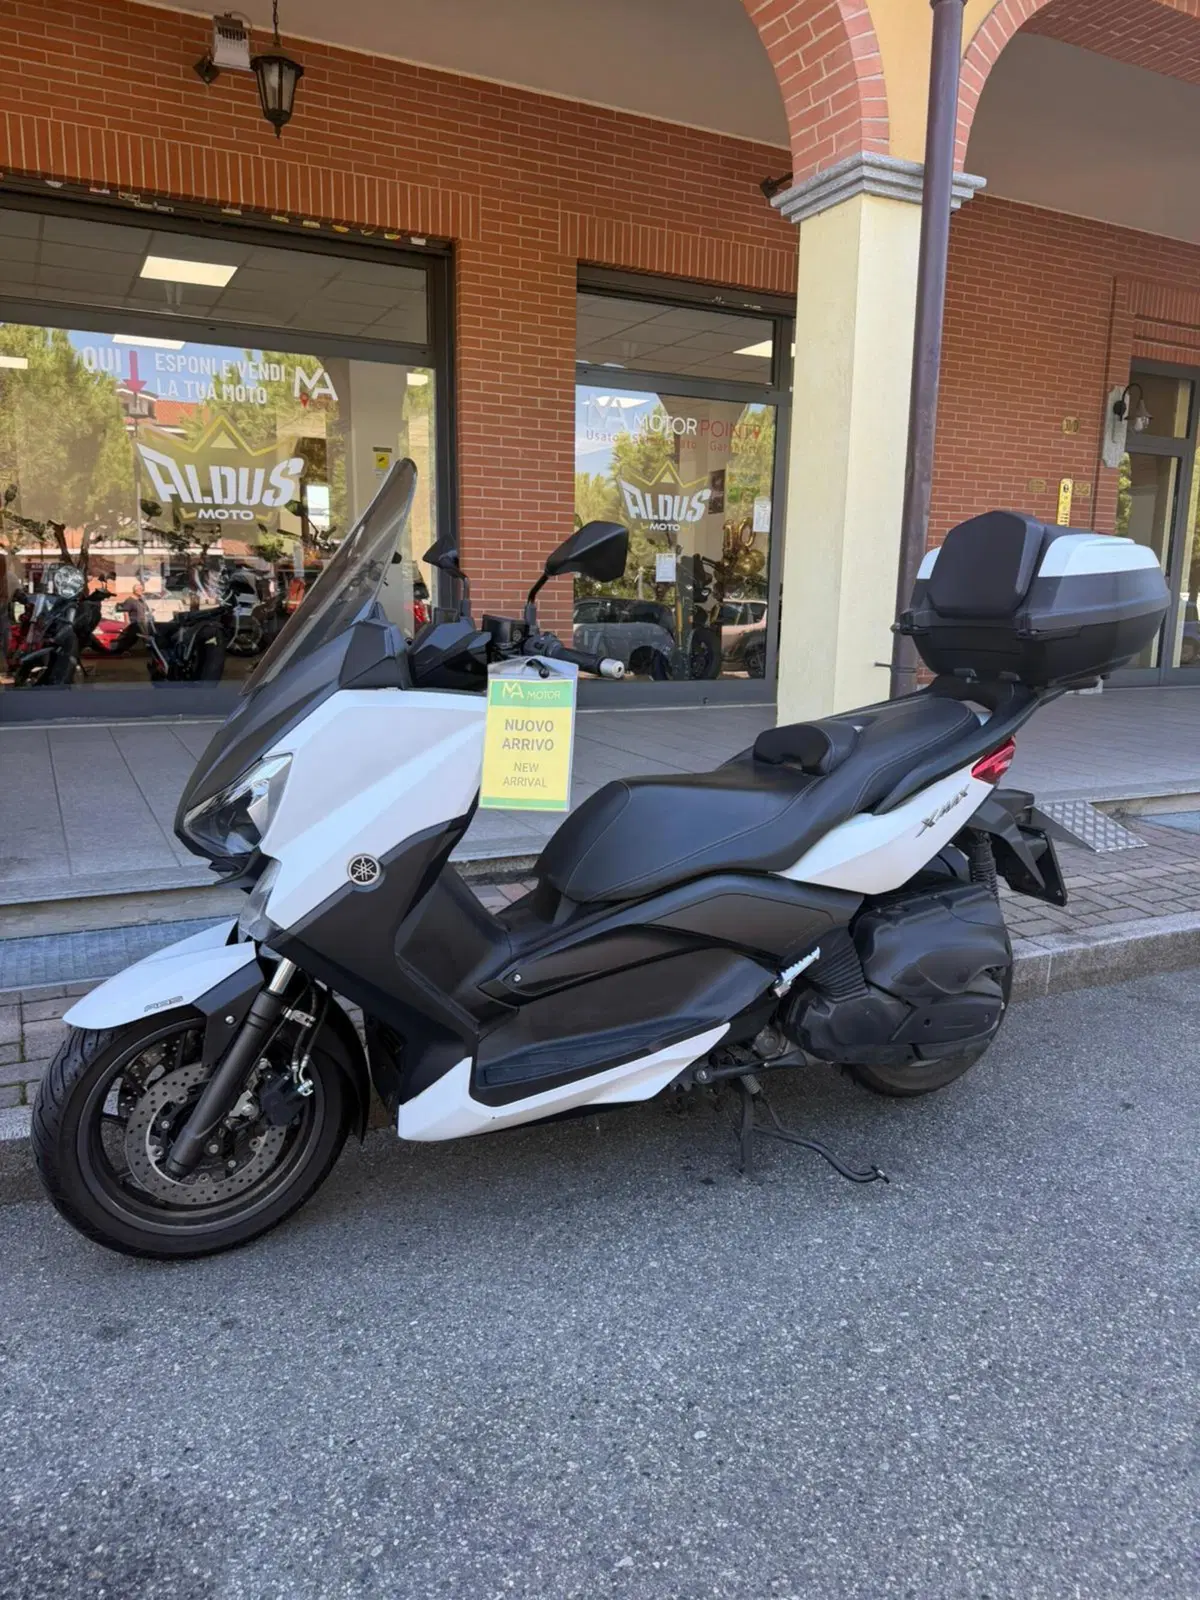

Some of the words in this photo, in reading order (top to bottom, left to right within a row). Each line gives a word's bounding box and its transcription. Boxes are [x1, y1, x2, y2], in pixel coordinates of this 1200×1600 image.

[83, 346, 121, 374] QUI
[155, 352, 215, 375] ESPONI
[221, 361, 232, 376] E
[235, 361, 286, 382] VENDI
[156, 379, 178, 397] LA
[184, 381, 216, 401] TUA
[222, 384, 268, 405] MOTO
[633, 414, 697, 436] MOTOR
[136, 442, 305, 507] ALDUS
[619, 479, 712, 522] ALDUS
[197, 508, 254, 521] MOTO
[649, 523, 681, 532] MOTO
[526, 690, 561, 700] MOTOR
[504, 719, 555, 733] NUOVO
[502, 738, 555, 751] ARRIVO
[513, 762, 540, 773] NEW
[502, 777, 548, 788] ARRIVAL
